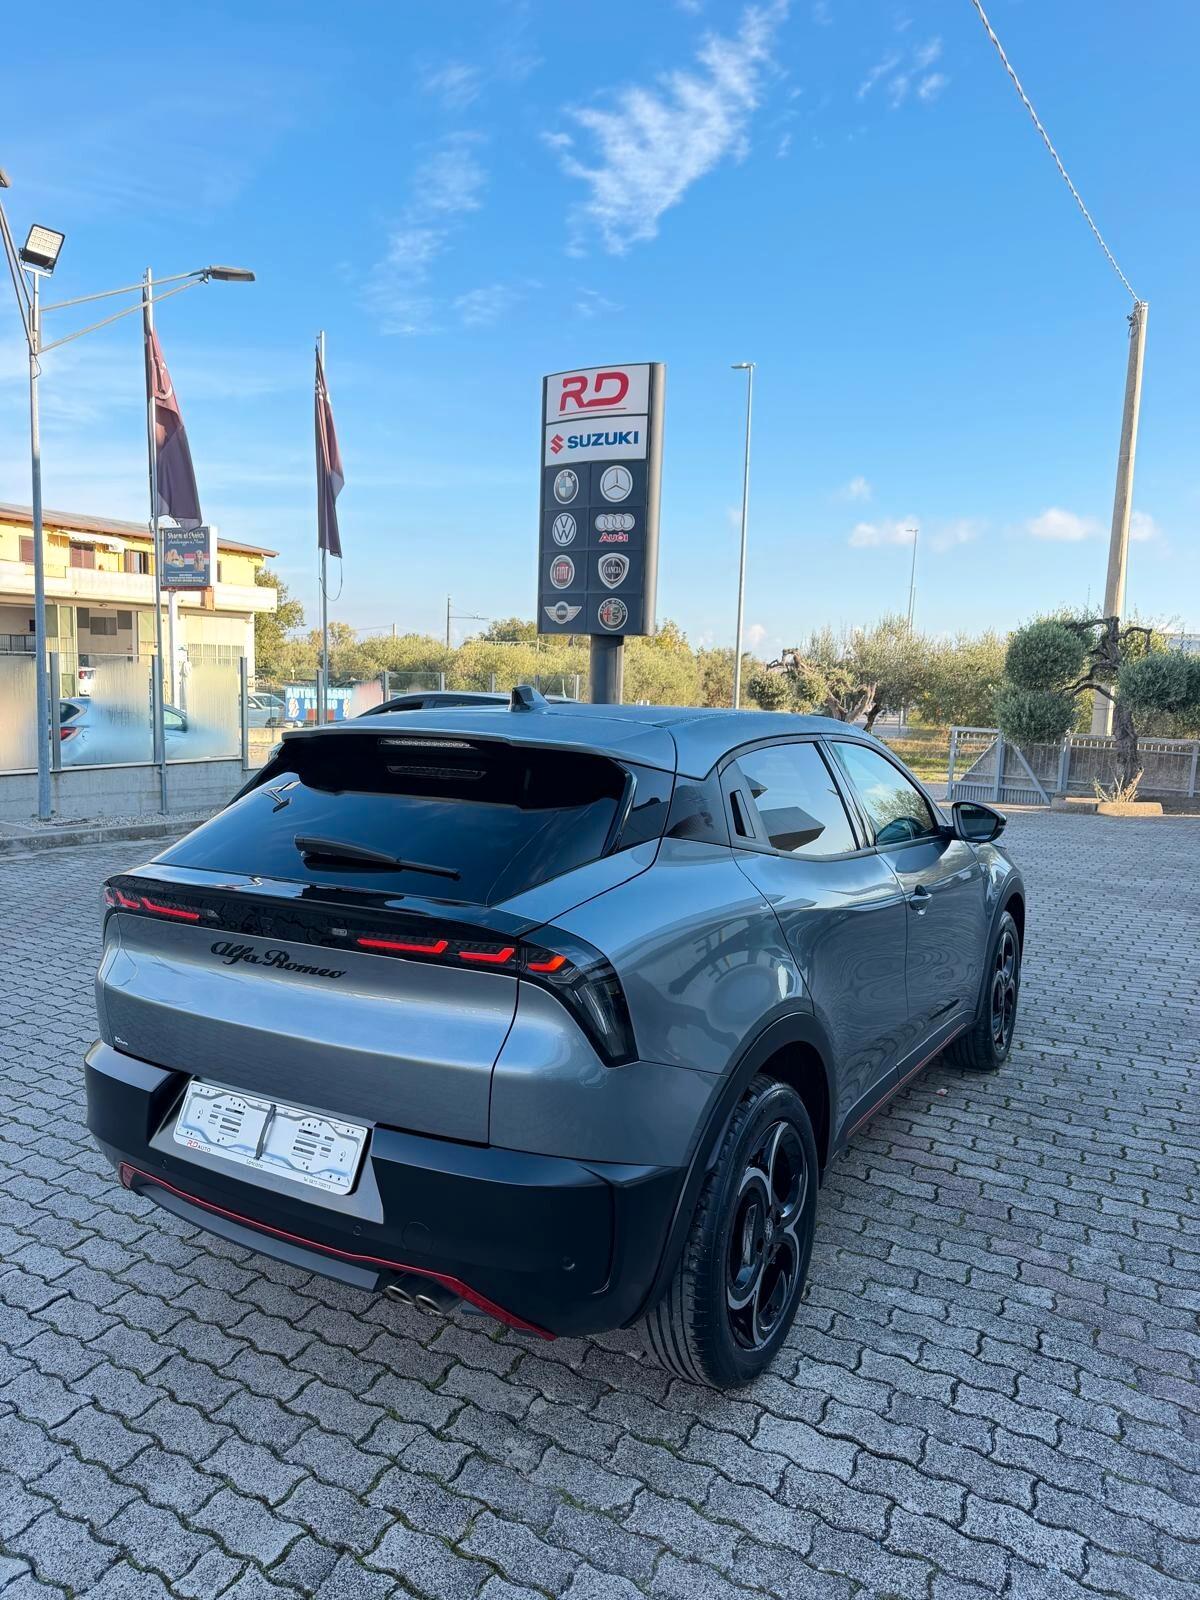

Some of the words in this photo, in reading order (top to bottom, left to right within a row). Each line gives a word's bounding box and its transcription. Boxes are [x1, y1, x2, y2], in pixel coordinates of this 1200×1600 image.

[560, 372, 629, 411] RD
[567, 431, 639, 449] SUZUKI
[599, 532, 628, 542] Audi
[557, 566, 569, 579] FIAT
[210, 941, 263, 965] Alfa
[262, 949, 347, 979] Romeo
